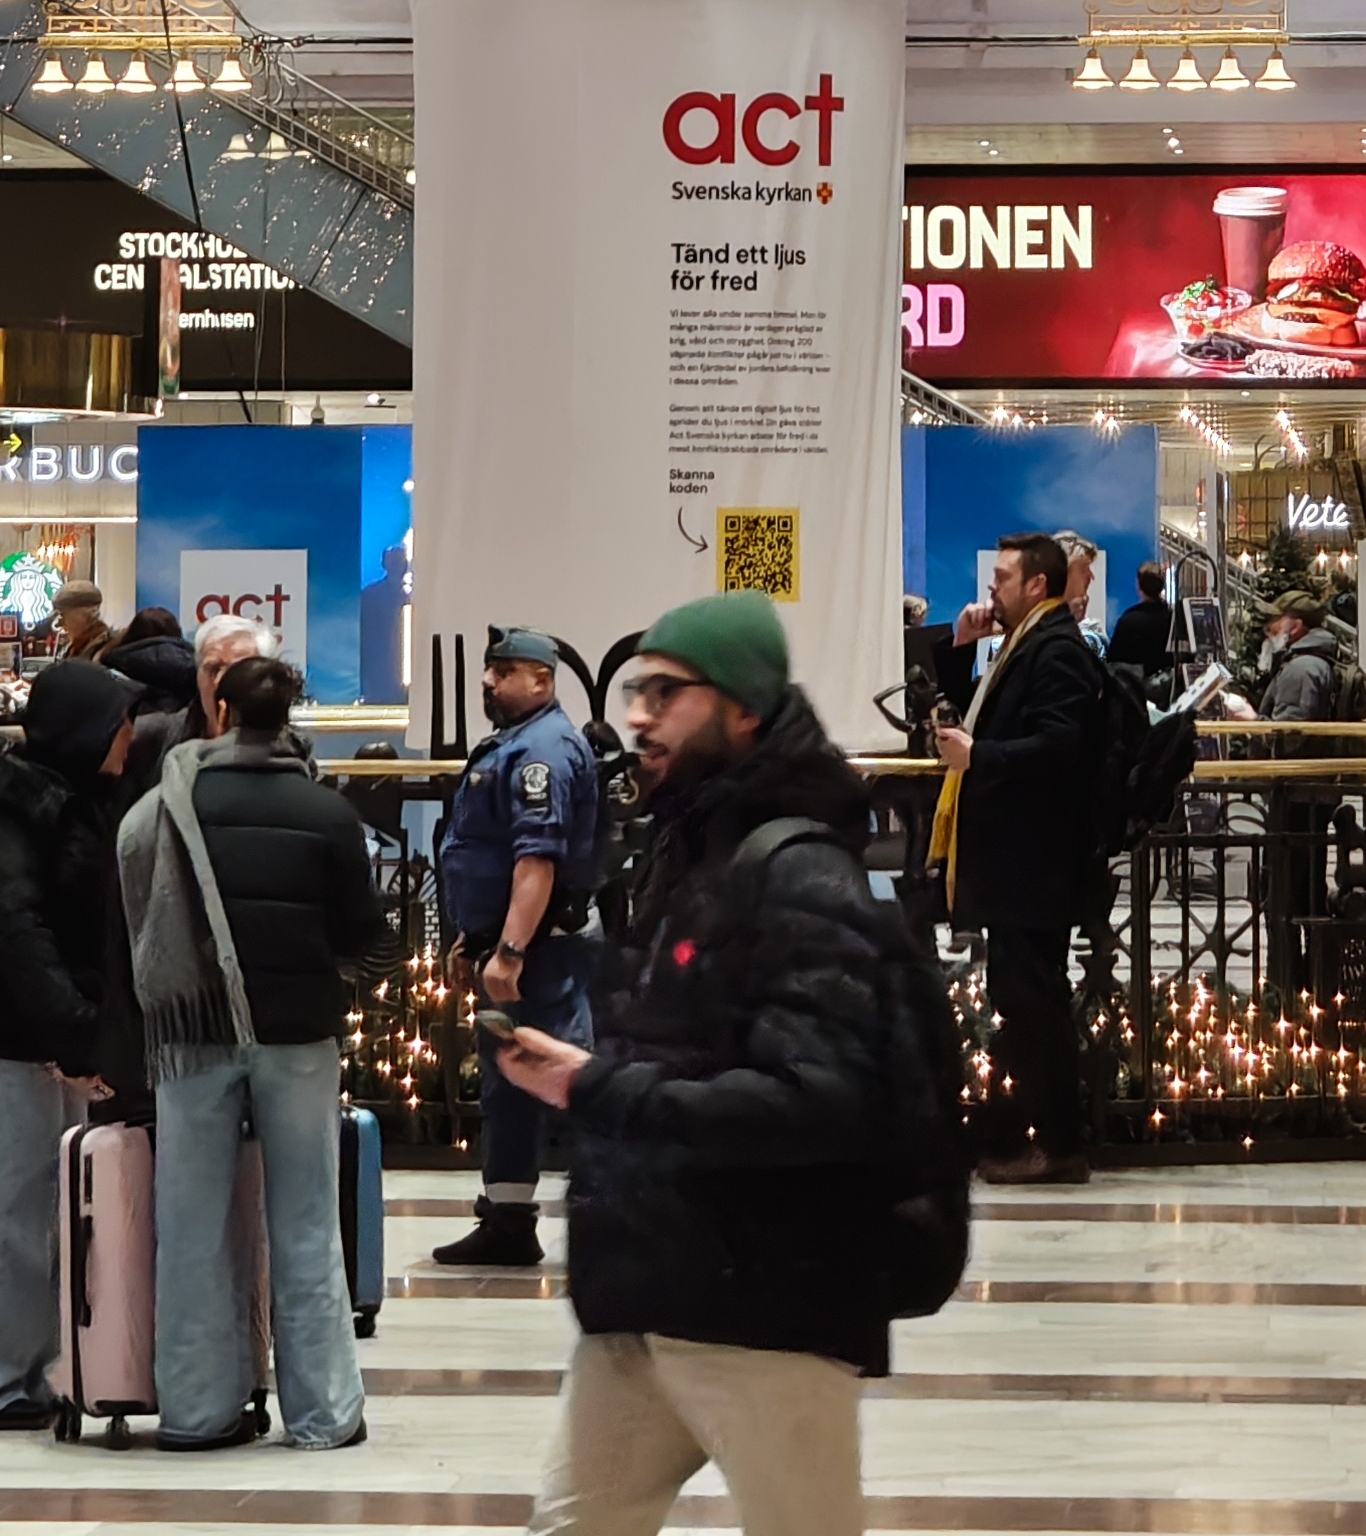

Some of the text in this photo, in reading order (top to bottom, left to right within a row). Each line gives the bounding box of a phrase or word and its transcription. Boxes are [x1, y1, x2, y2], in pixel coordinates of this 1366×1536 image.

[662, 73, 844, 166] act
[671, 181, 812, 205] Svenska kyrkan
[671, 242, 806, 270] Tänd ett ljus
[671, 269, 758, 292] för fred
[178, 309, 254, 329] ernhusen
[901, 283, 965, 347] RD
[669, 469, 715, 480] Skanna
[669, 482, 708, 494] koden
[1288, 492, 1350, 527] Vete
[196, 584, 290, 627] act
